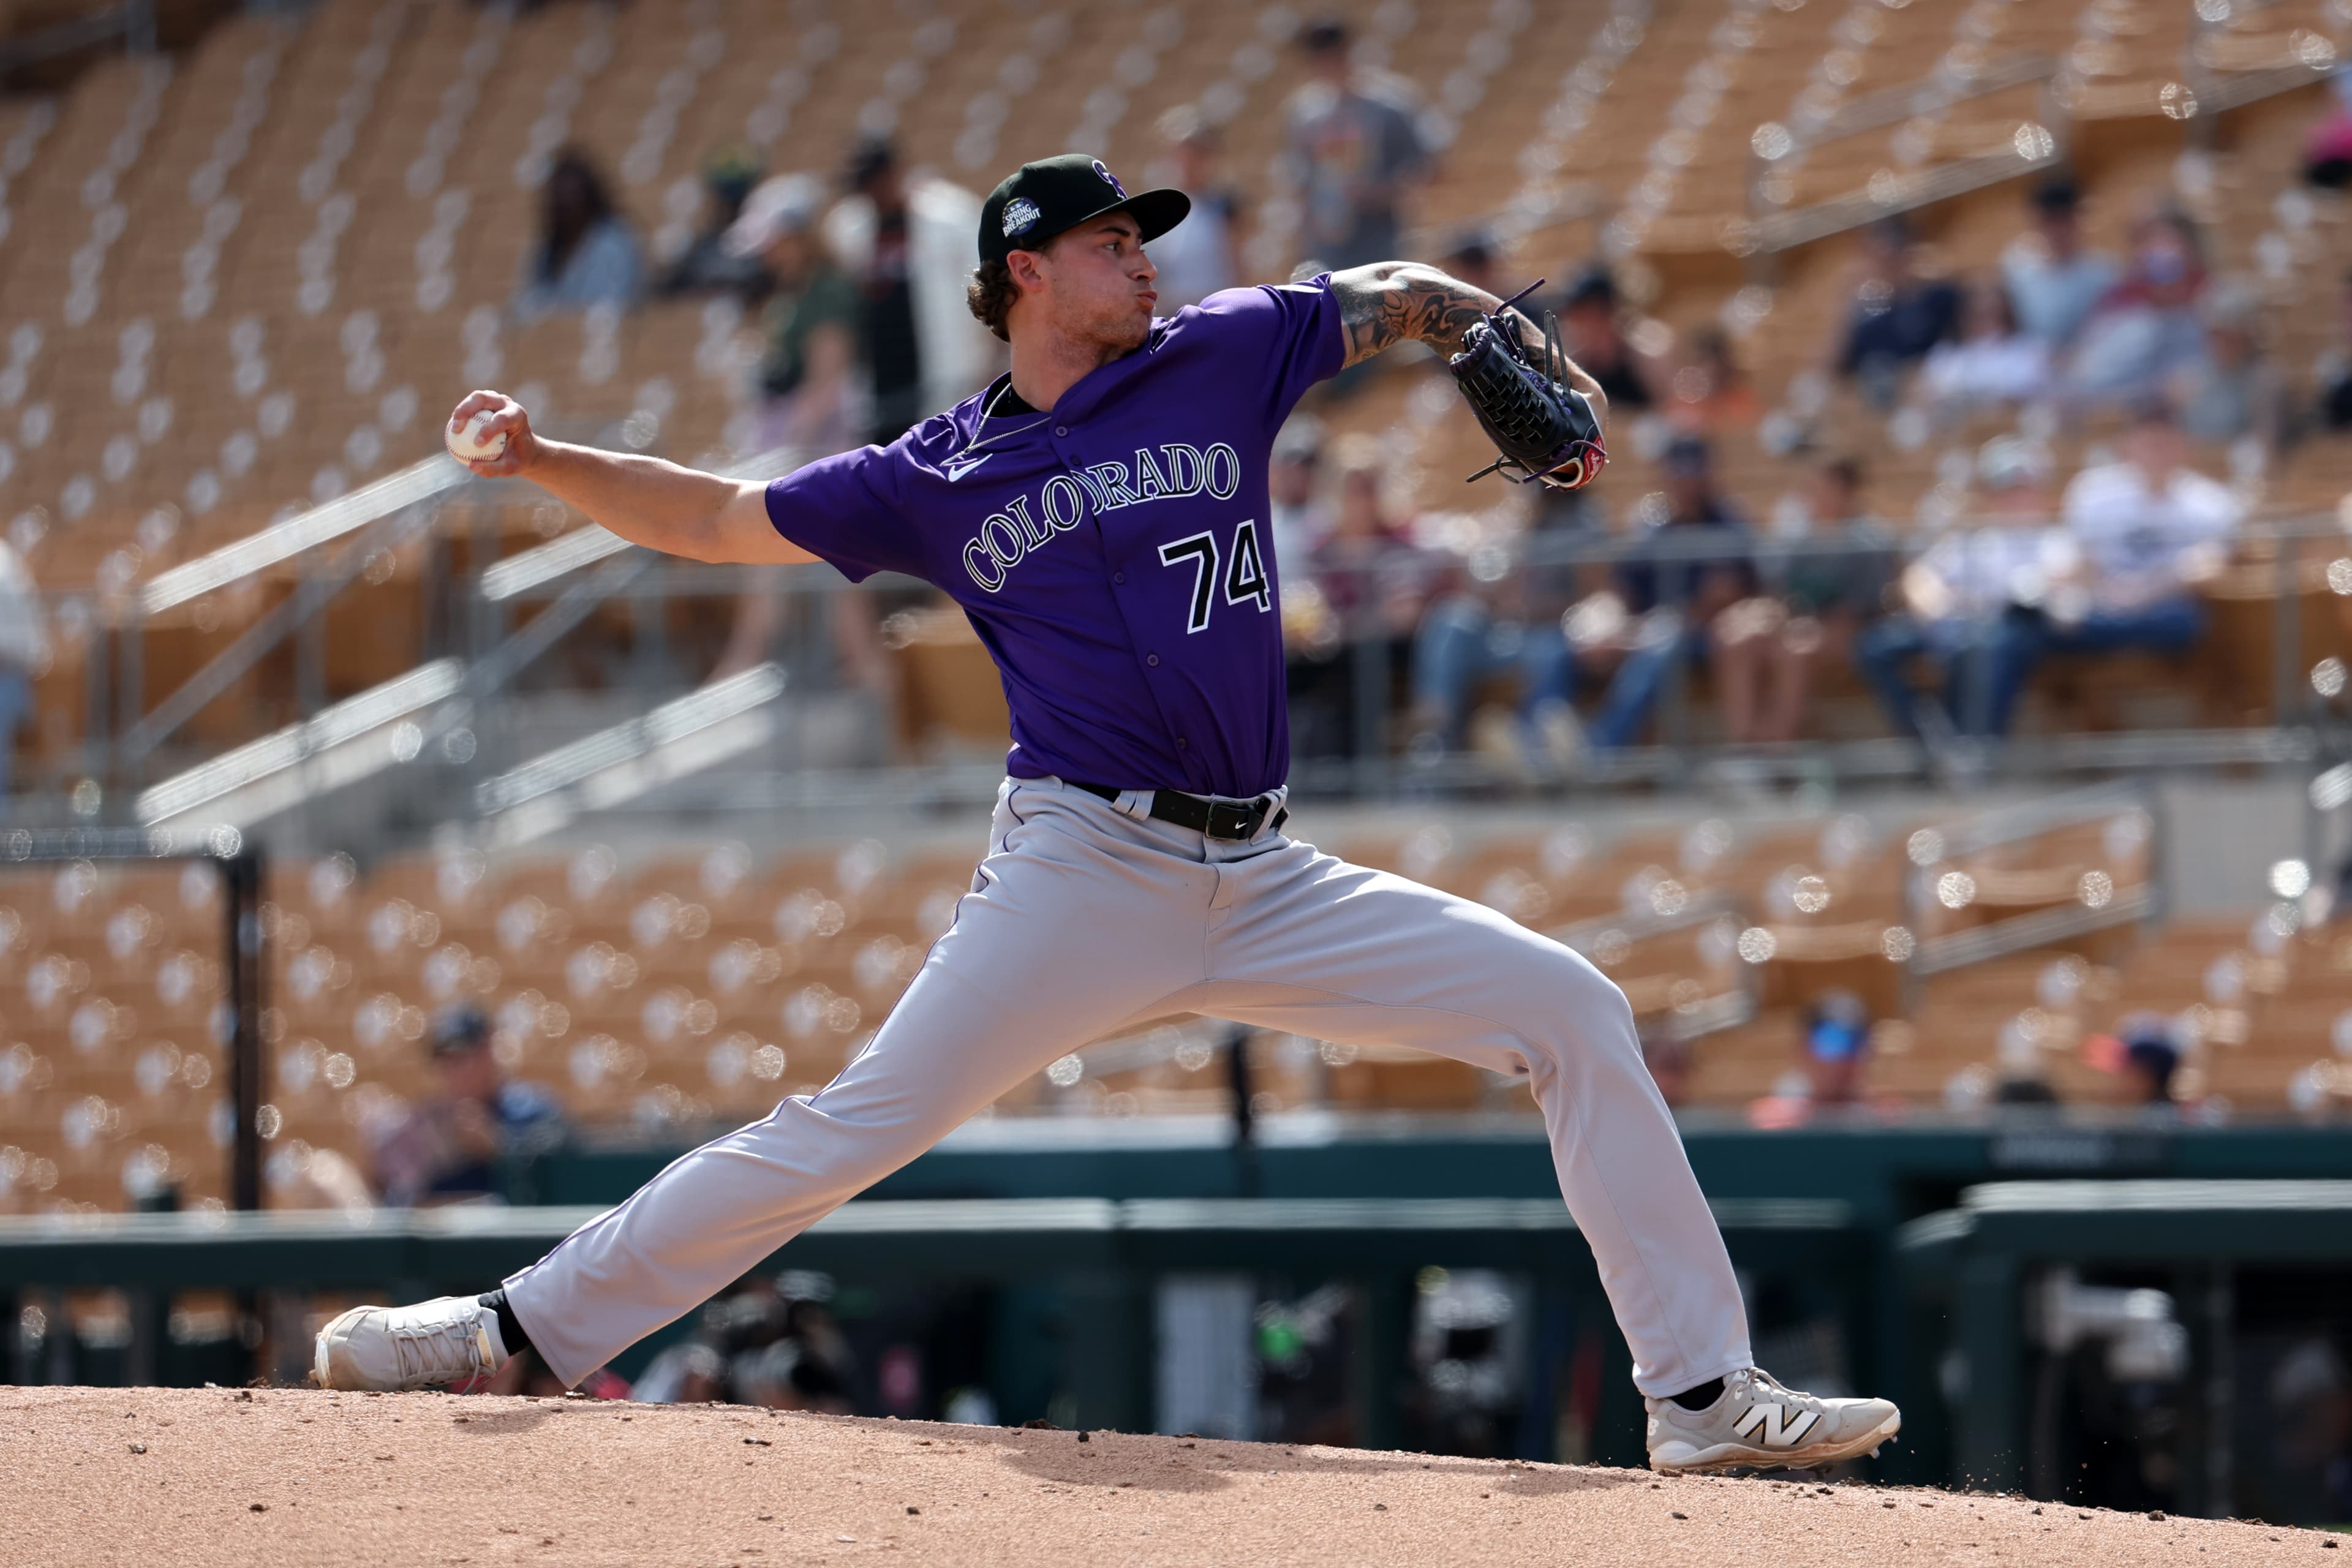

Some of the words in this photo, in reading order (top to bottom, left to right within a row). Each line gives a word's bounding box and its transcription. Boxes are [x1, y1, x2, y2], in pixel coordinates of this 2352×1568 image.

[1003, 208, 1041, 238] BREAKOUT
[1005, 204, 1031, 224] SPRING
[963, 443, 1239, 593] COLORADO
[1158, 519, 1271, 635] 74
